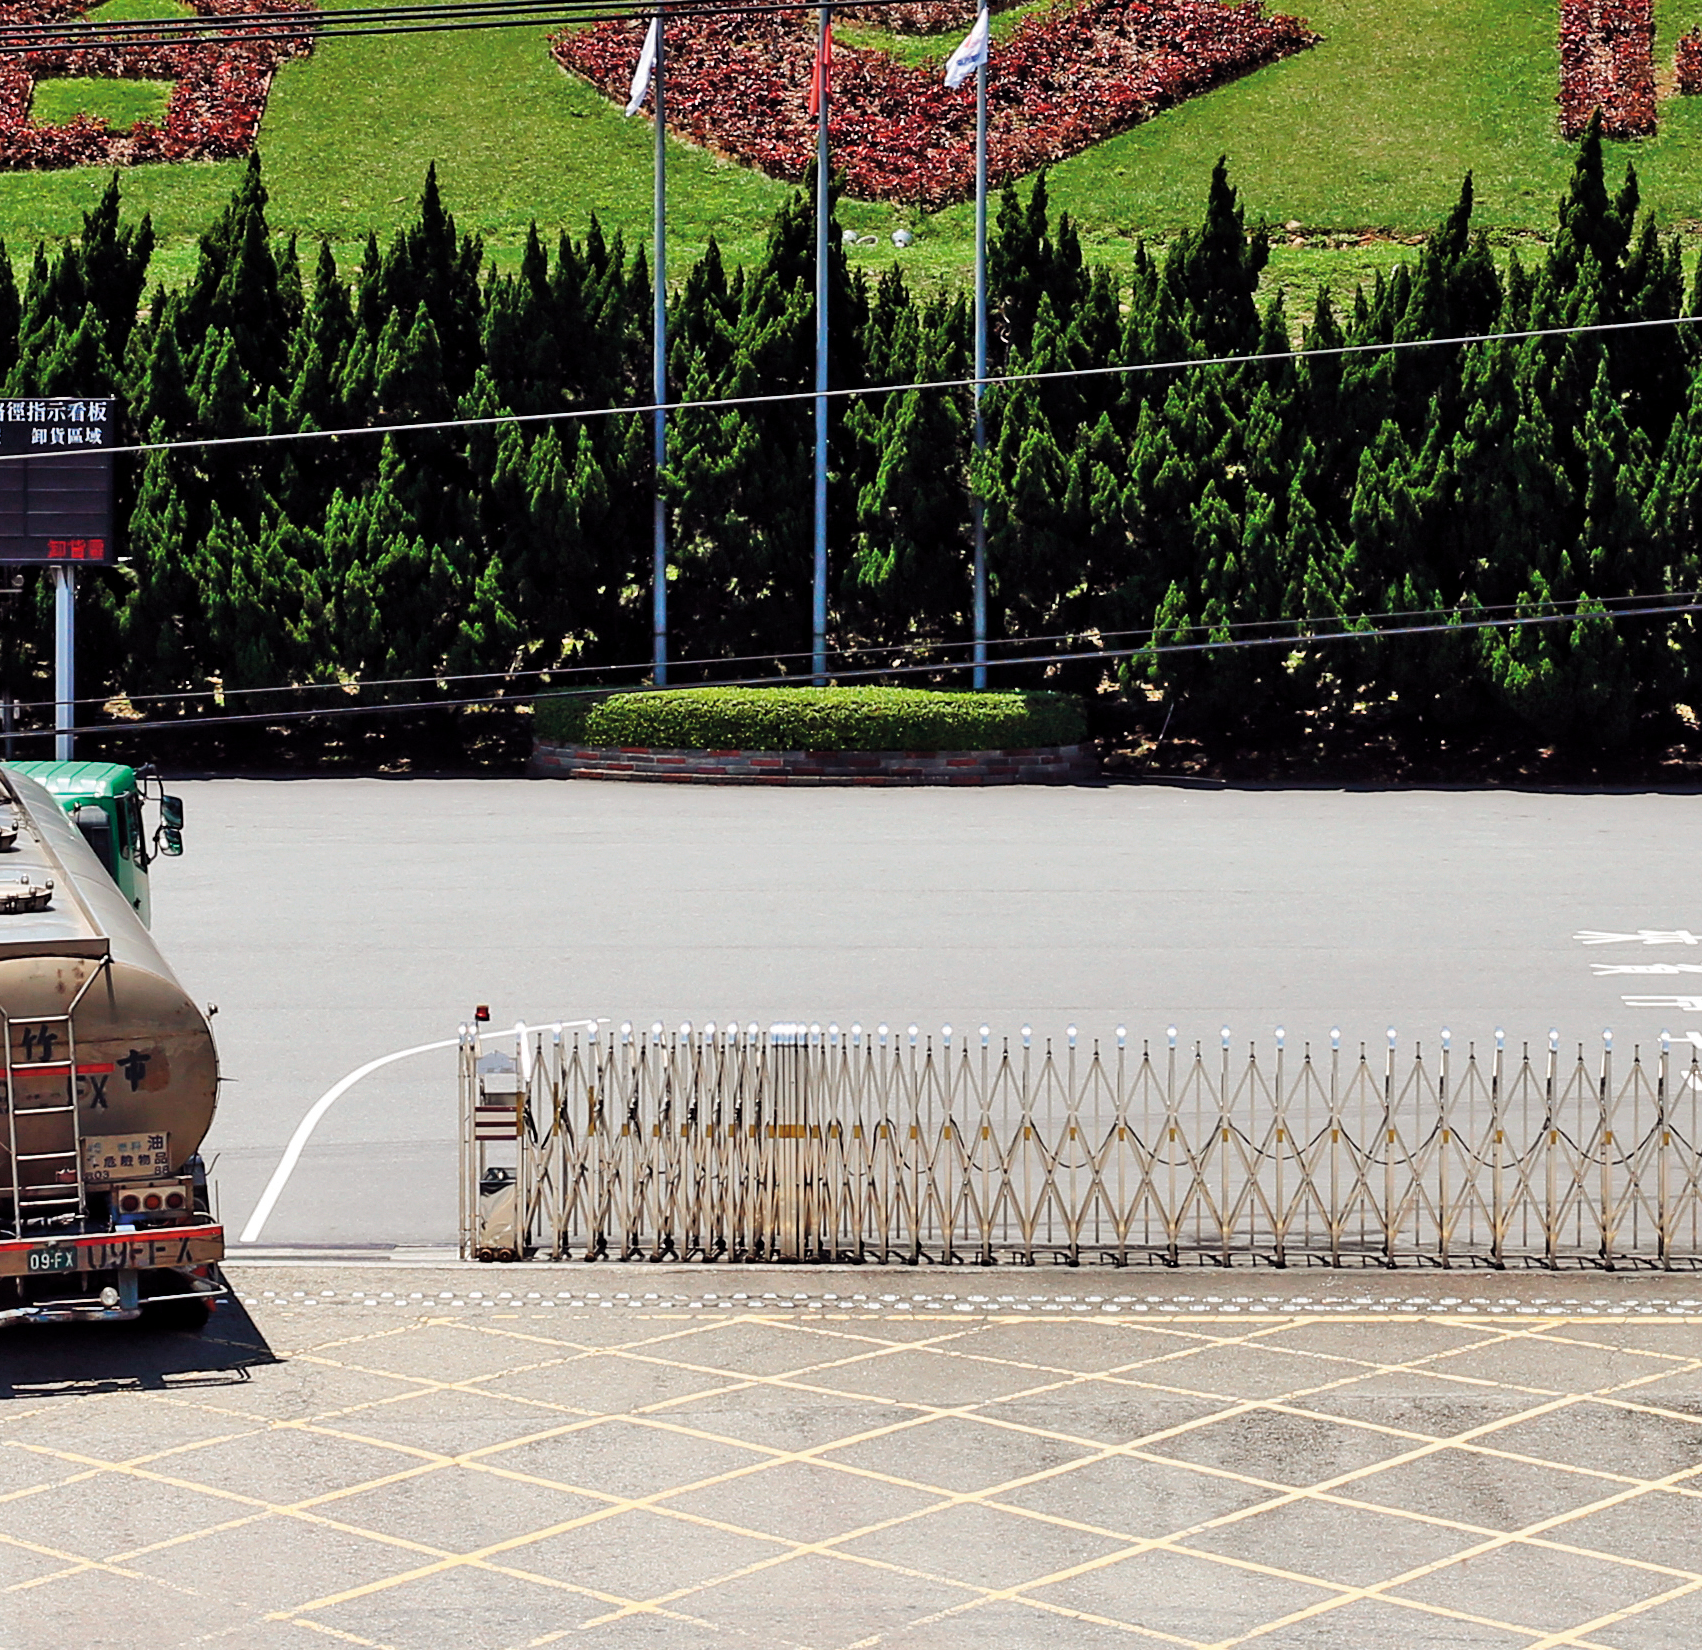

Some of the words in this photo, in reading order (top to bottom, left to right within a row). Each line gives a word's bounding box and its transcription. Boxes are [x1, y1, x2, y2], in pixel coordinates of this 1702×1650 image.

[31, 427, 103, 445] 卸貨區域
[30, 1252, 74, 1269] 09-FX
